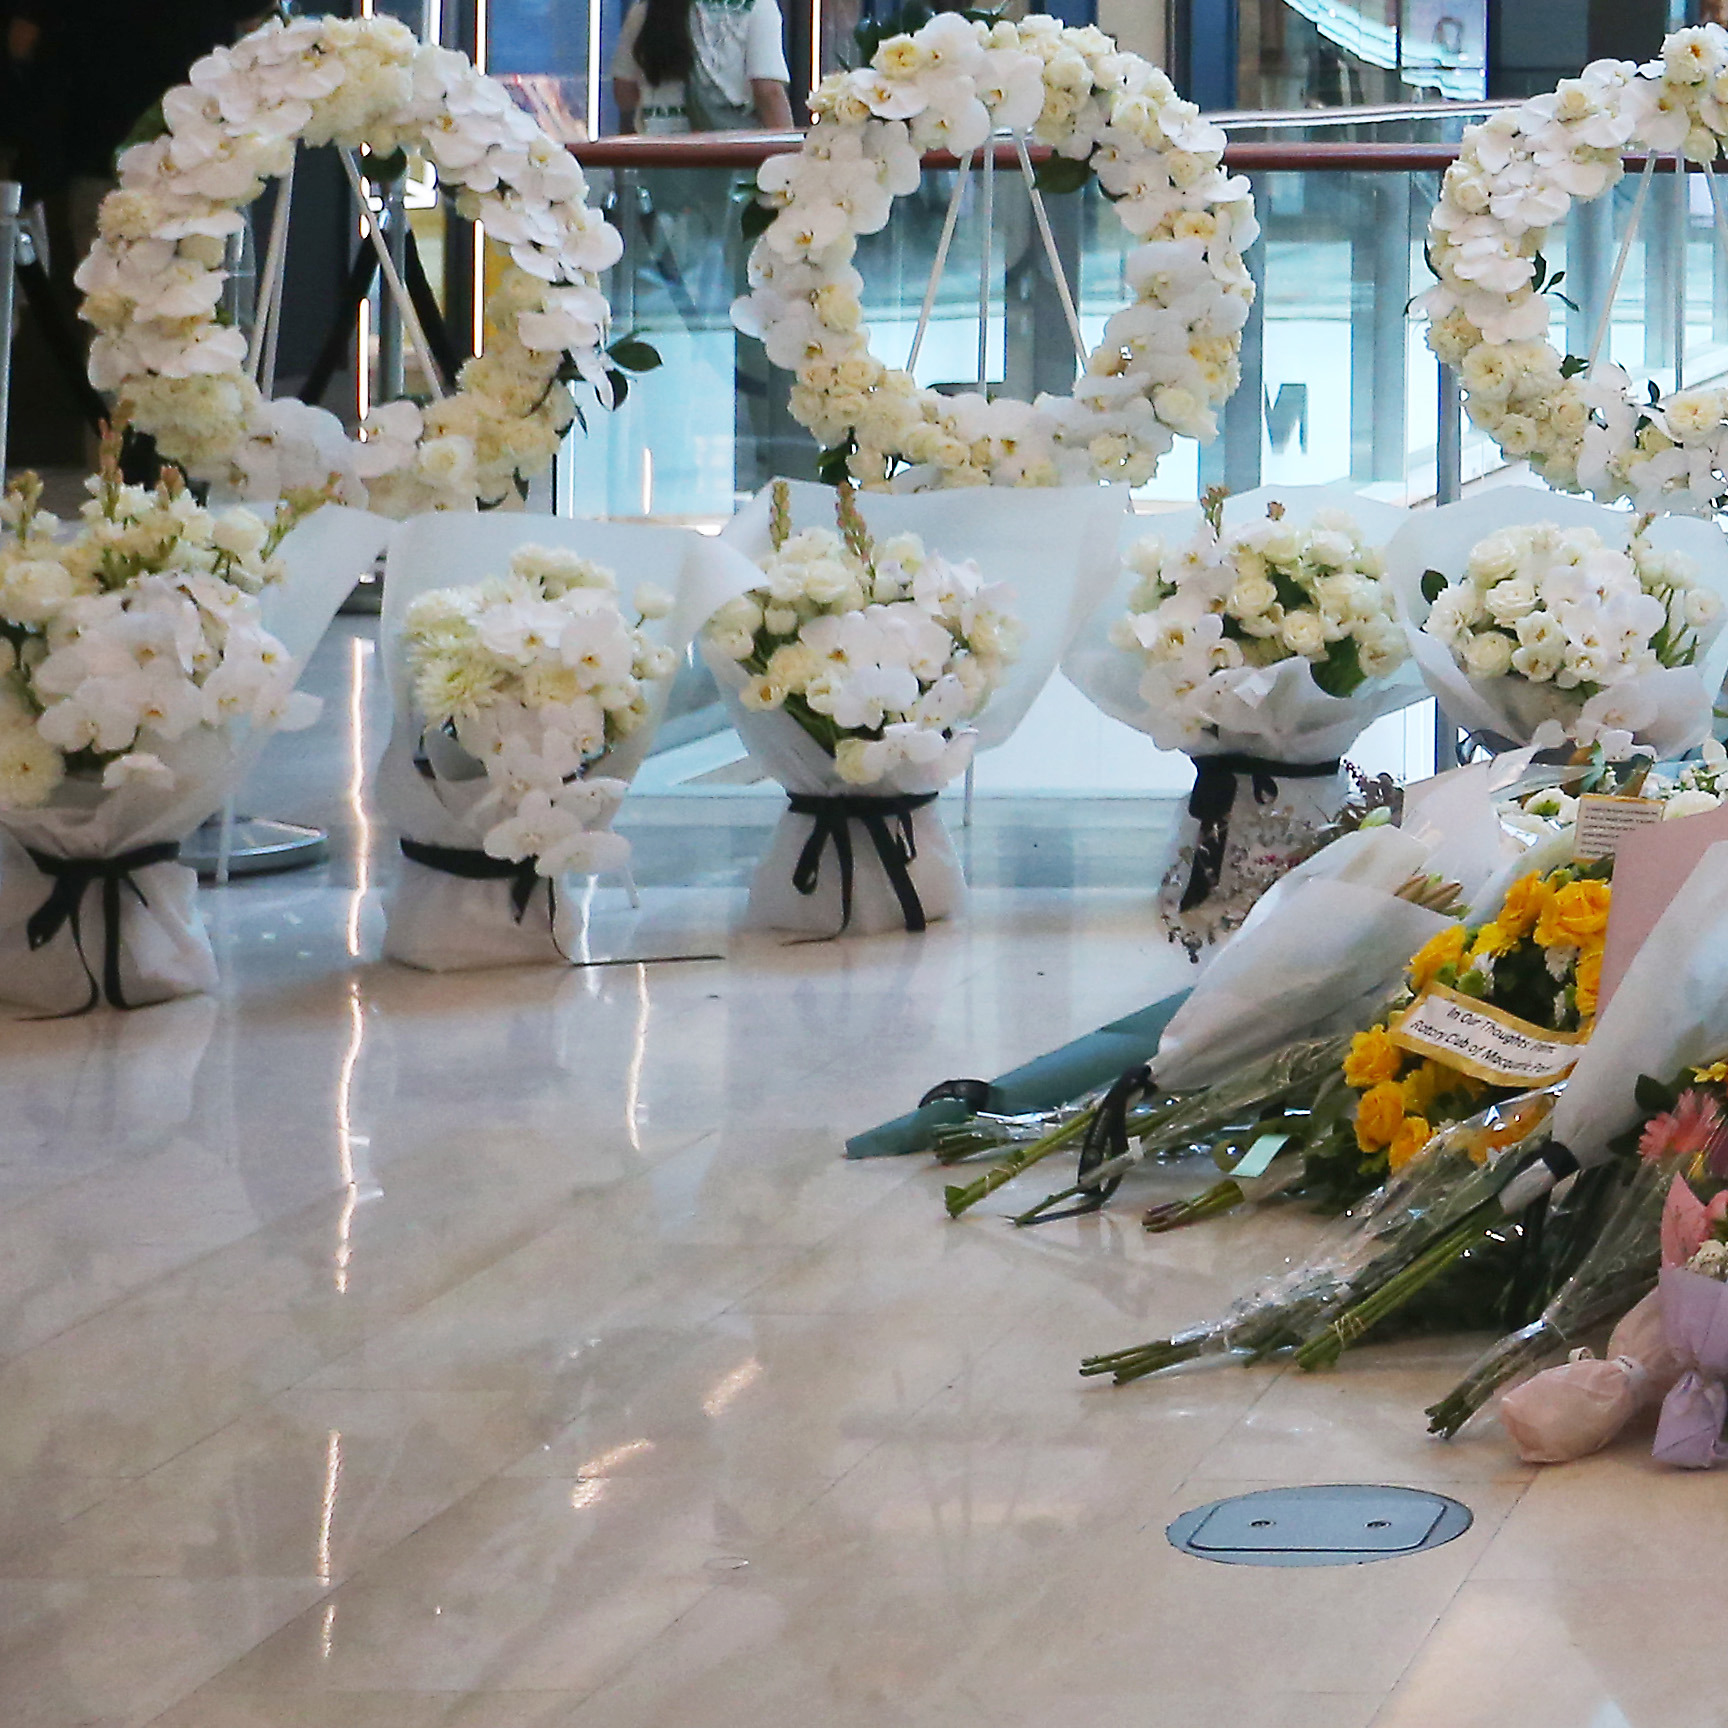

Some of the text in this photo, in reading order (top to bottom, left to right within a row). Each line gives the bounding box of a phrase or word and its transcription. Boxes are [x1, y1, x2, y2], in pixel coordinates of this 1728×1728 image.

[1410, 1020, 1446, 1041] Rotary
[1445, 1033, 1469, 1049] Club
[1468, 1044, 1484, 1056] of
[1446, 1007, 1460, 1020] In
[1460, 1012, 1481, 1026] Our
[1481, 1021, 1529, 1049] Thoughts
